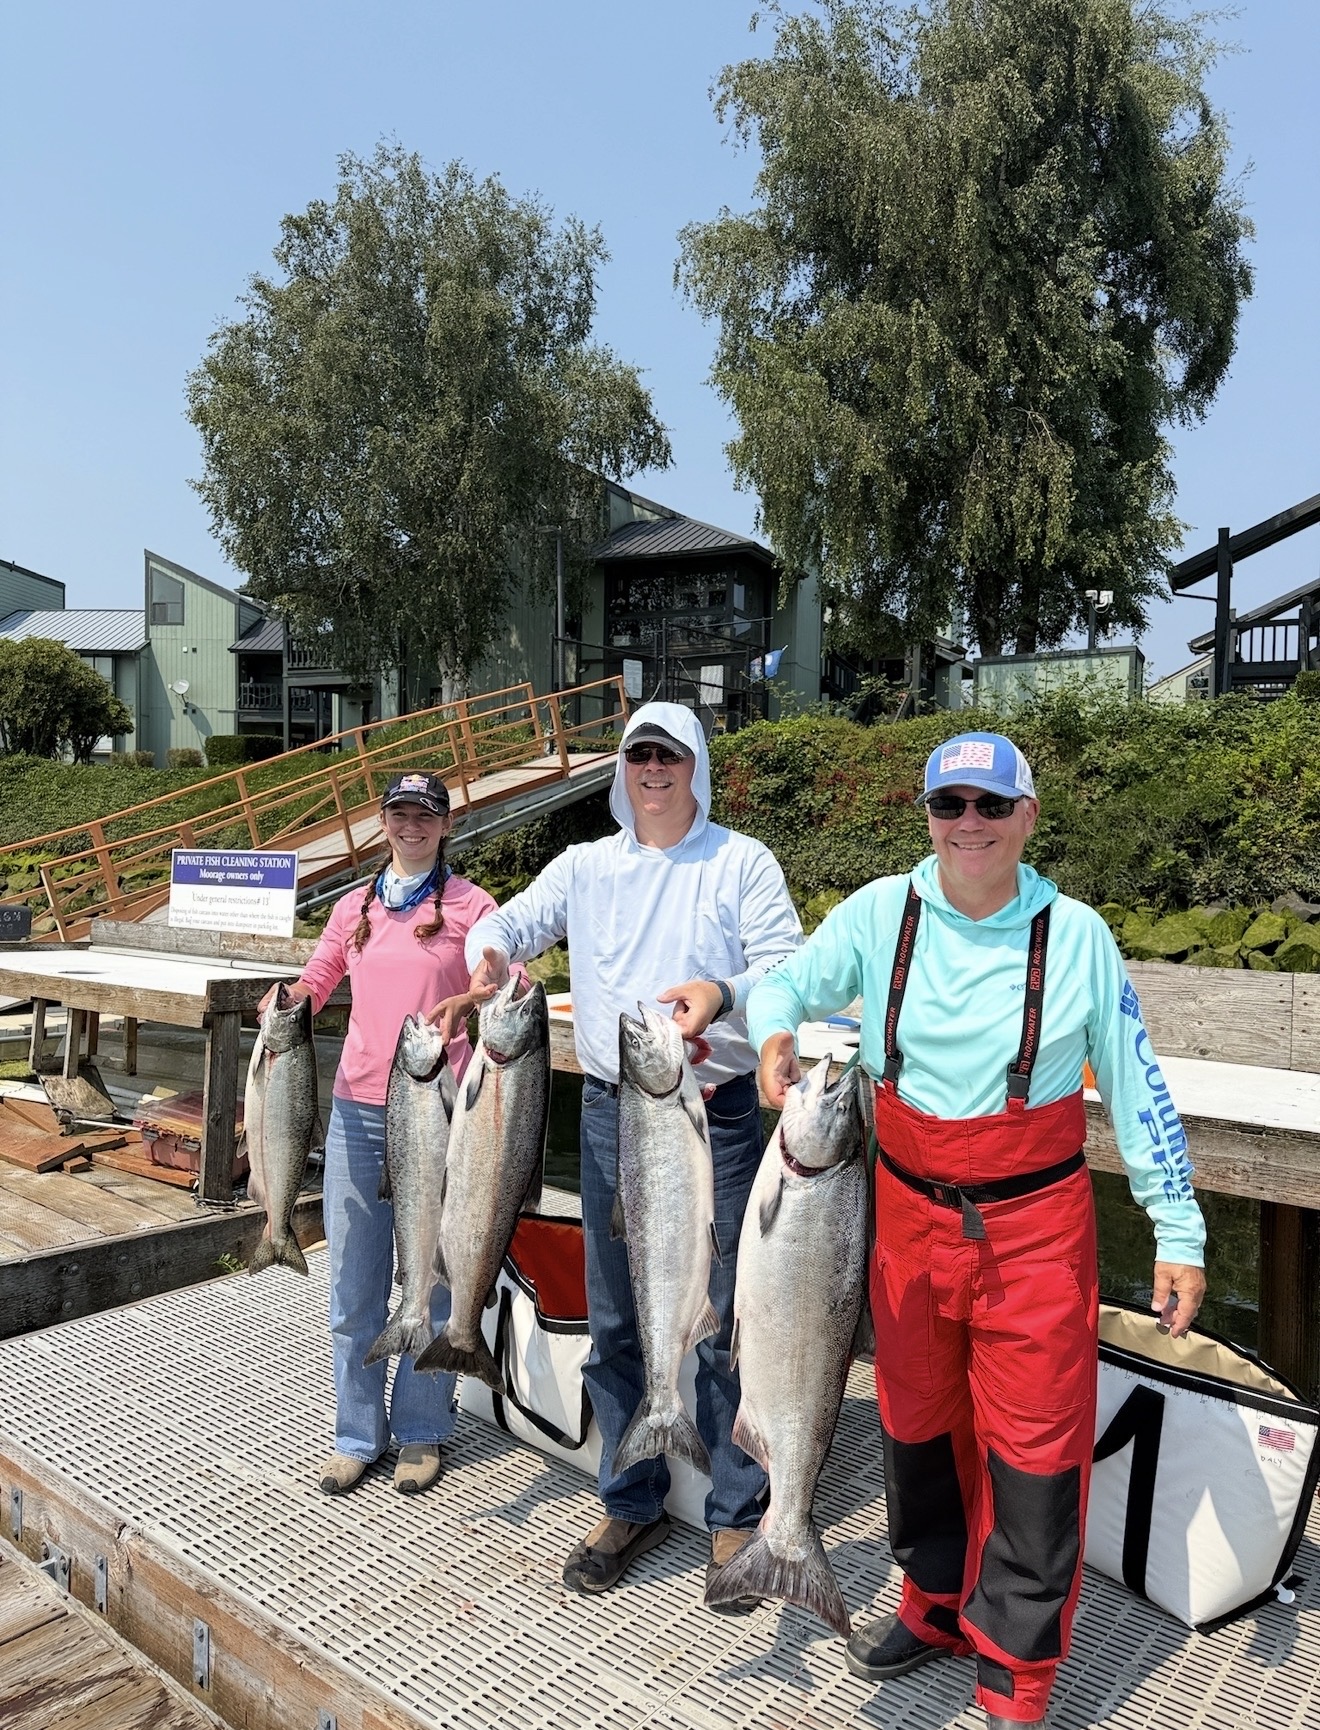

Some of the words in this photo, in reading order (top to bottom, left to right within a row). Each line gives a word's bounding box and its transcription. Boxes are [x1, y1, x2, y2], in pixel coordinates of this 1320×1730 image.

[176, 856, 204, 866] PRIVATE
[205, 856, 220, 867] FISH
[222, 856, 258, 868] CLEANING
[259, 857, 291, 869] STATION
[200, 868, 226, 882] Moorage
[226, 872, 248, 880] owners
[250, 870, 264, 884] only
[192, 891, 208, 903] Under
[208, 894, 228, 906] general
[898, 915, 915, 965] ROCKWATER
[1032, 918, 1045, 966] ROCKWATER
[886, 1006, 896, 1057] ROCKWATER
[1024, 1007, 1037, 1059] ROCKWATER
